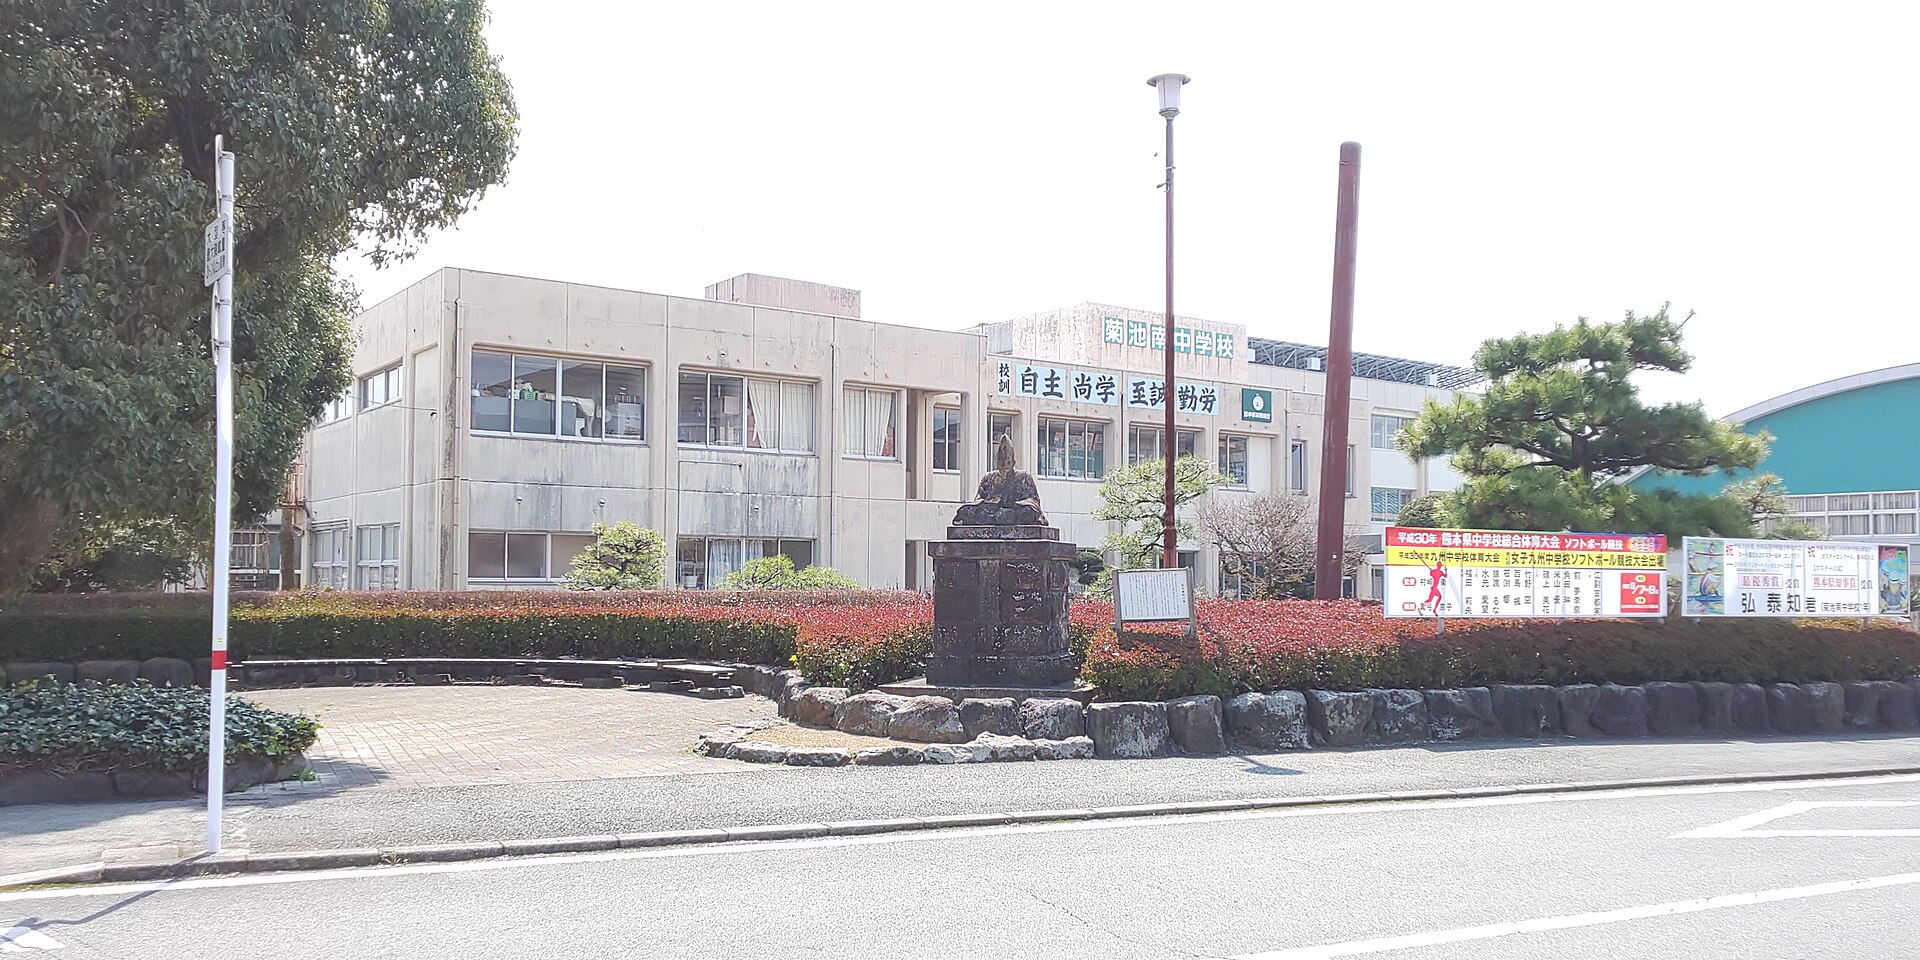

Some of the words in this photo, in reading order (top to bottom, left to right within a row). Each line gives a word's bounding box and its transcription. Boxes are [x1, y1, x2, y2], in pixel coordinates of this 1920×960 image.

[1105, 318, 1233, 358] 菊池南中学校
[999, 363, 1010, 395] 校訓
[1021, 366, 1063, 398] 自主
[1073, 373, 1116, 404] 尚学
[1130, 381, 1165, 406] 至誠
[1178, 385, 1217, 413] 勤労
[1397, 532, 1438, 545] 平成30年
[1441, 533, 1560, 549] 熊本県中学校総合体育大会
[1564, 538, 1623, 550] ソフトボール競技
[1813, 577, 1857, 589] 熊本県知事賞
